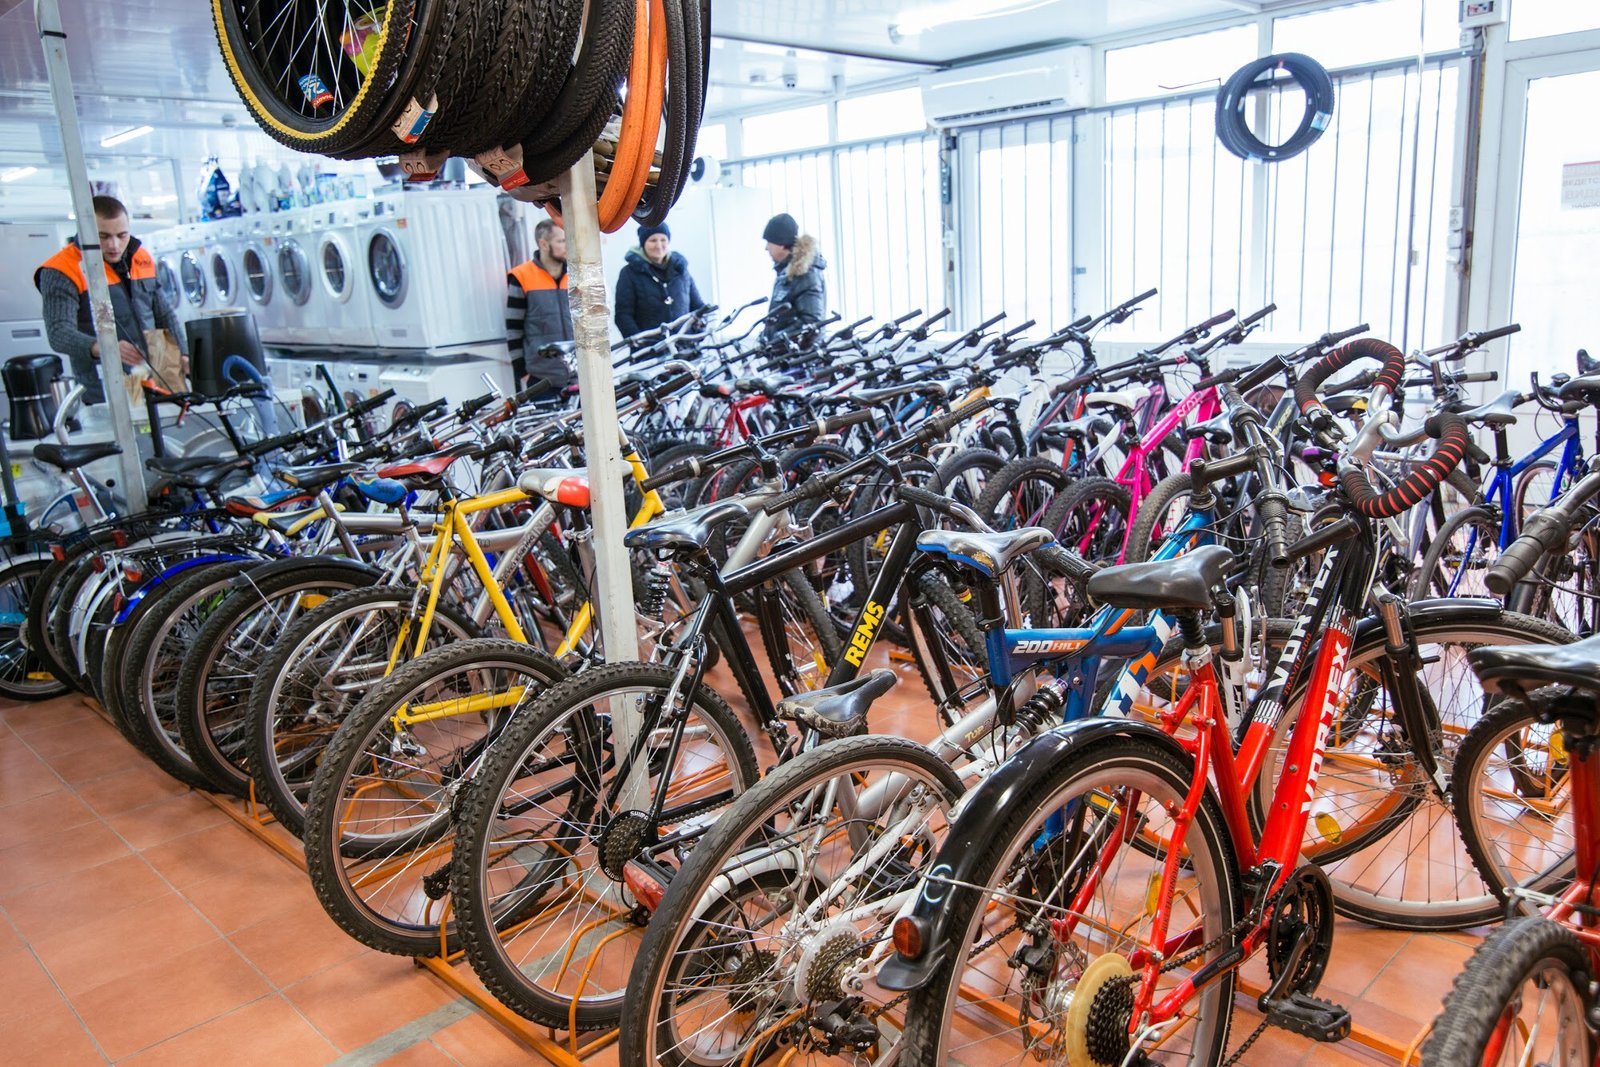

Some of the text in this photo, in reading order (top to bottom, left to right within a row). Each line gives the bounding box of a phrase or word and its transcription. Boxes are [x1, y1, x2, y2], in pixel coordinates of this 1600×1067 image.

[844, 600, 885, 668] REMS
[1267, 545, 1339, 691] VORTEX
[1299, 640, 1349, 815] VORTEX
